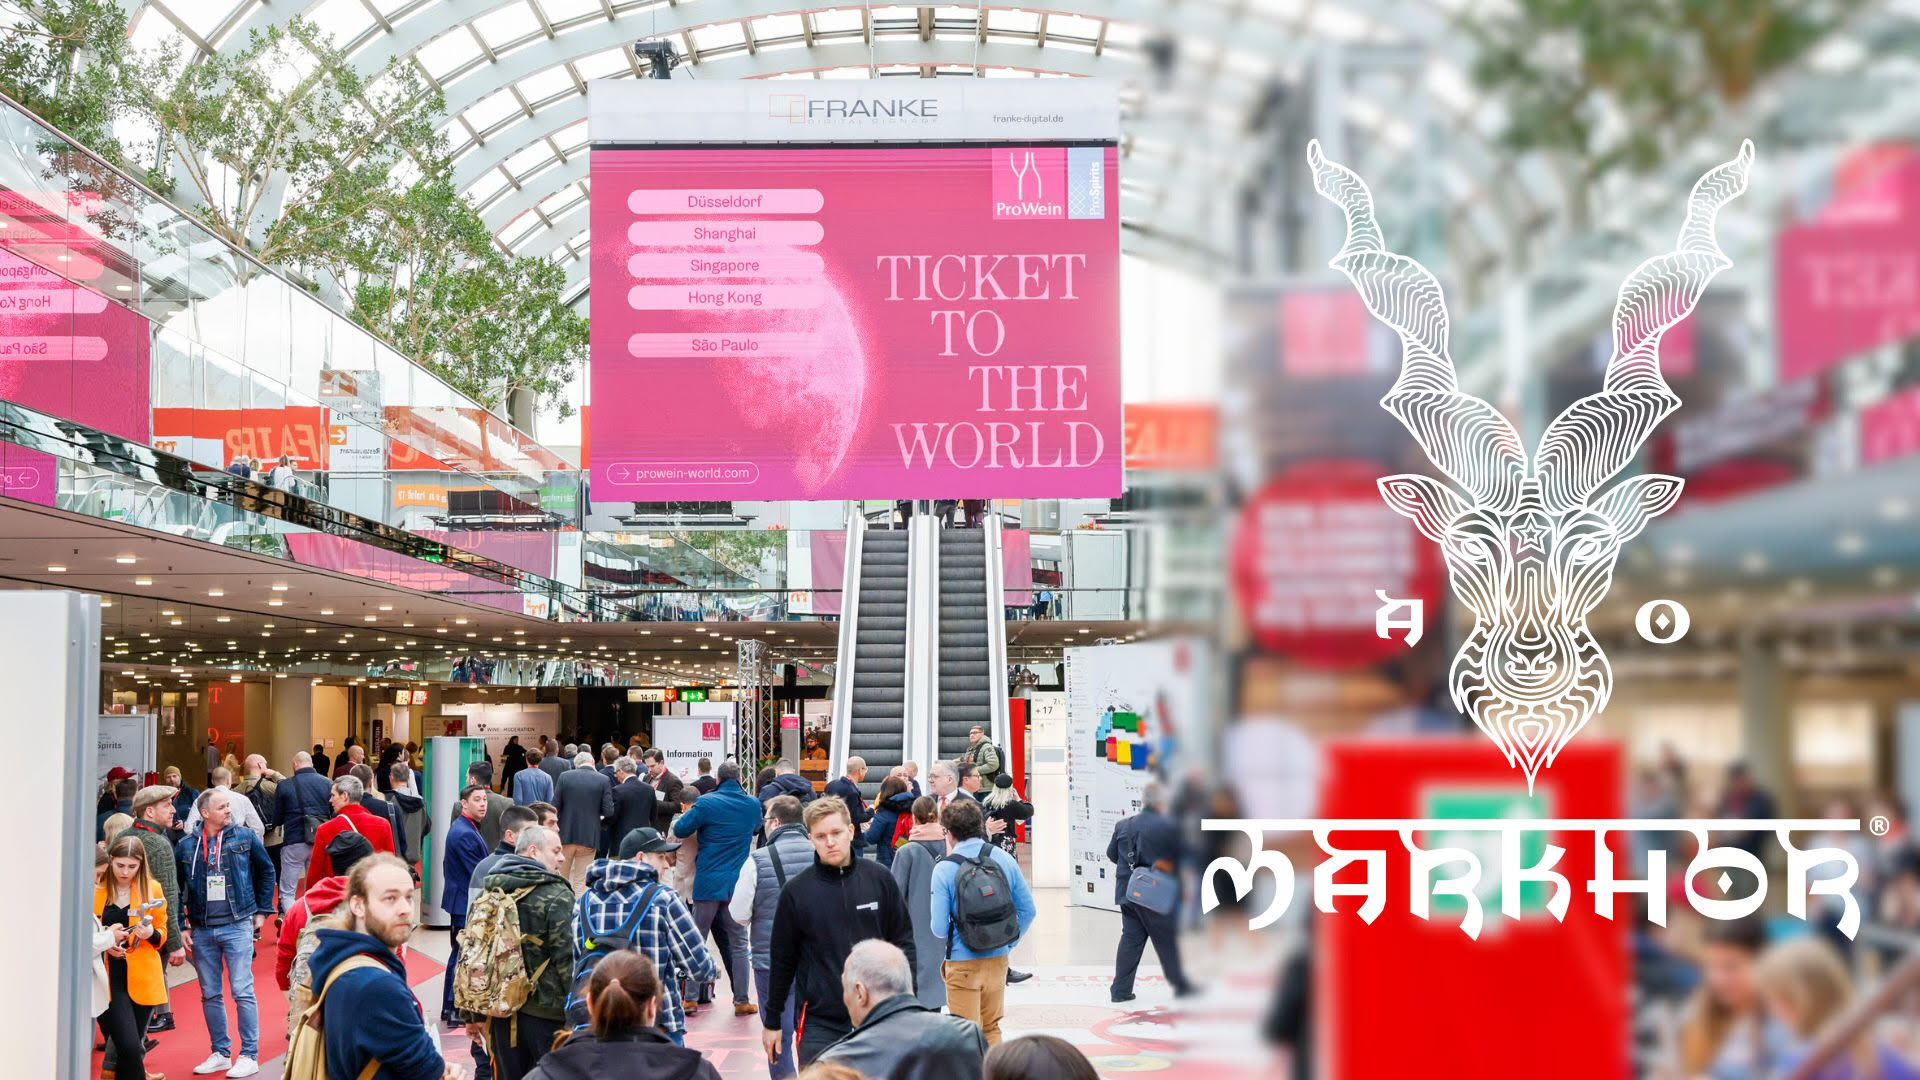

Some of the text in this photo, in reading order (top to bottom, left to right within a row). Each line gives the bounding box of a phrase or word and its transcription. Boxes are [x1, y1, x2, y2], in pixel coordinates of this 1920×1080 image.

[808, 99, 939, 118] FRANKE
[993, 114, 1065, 125] franke-digital.de
[1088, 161, 1102, 216] ProSpirits
[687, 195, 763, 208] Düsseldorf
[996, 201, 1063, 216] ProWein
[693, 227, 757, 242] Shanghai
[690, 259, 760, 274] Singapore
[876, 253, 1087, 302] TICKET
[688, 291, 763, 306] Hong Kong
[931, 309, 1006, 357] TO
[691, 338, 759, 351] São Paulo
[968, 365, 1088, 412] THE
[888, 421, 1104, 471] WORLD
[636, 467, 750, 481] prowein-world.com
[666, 749, 713, 759] Information
